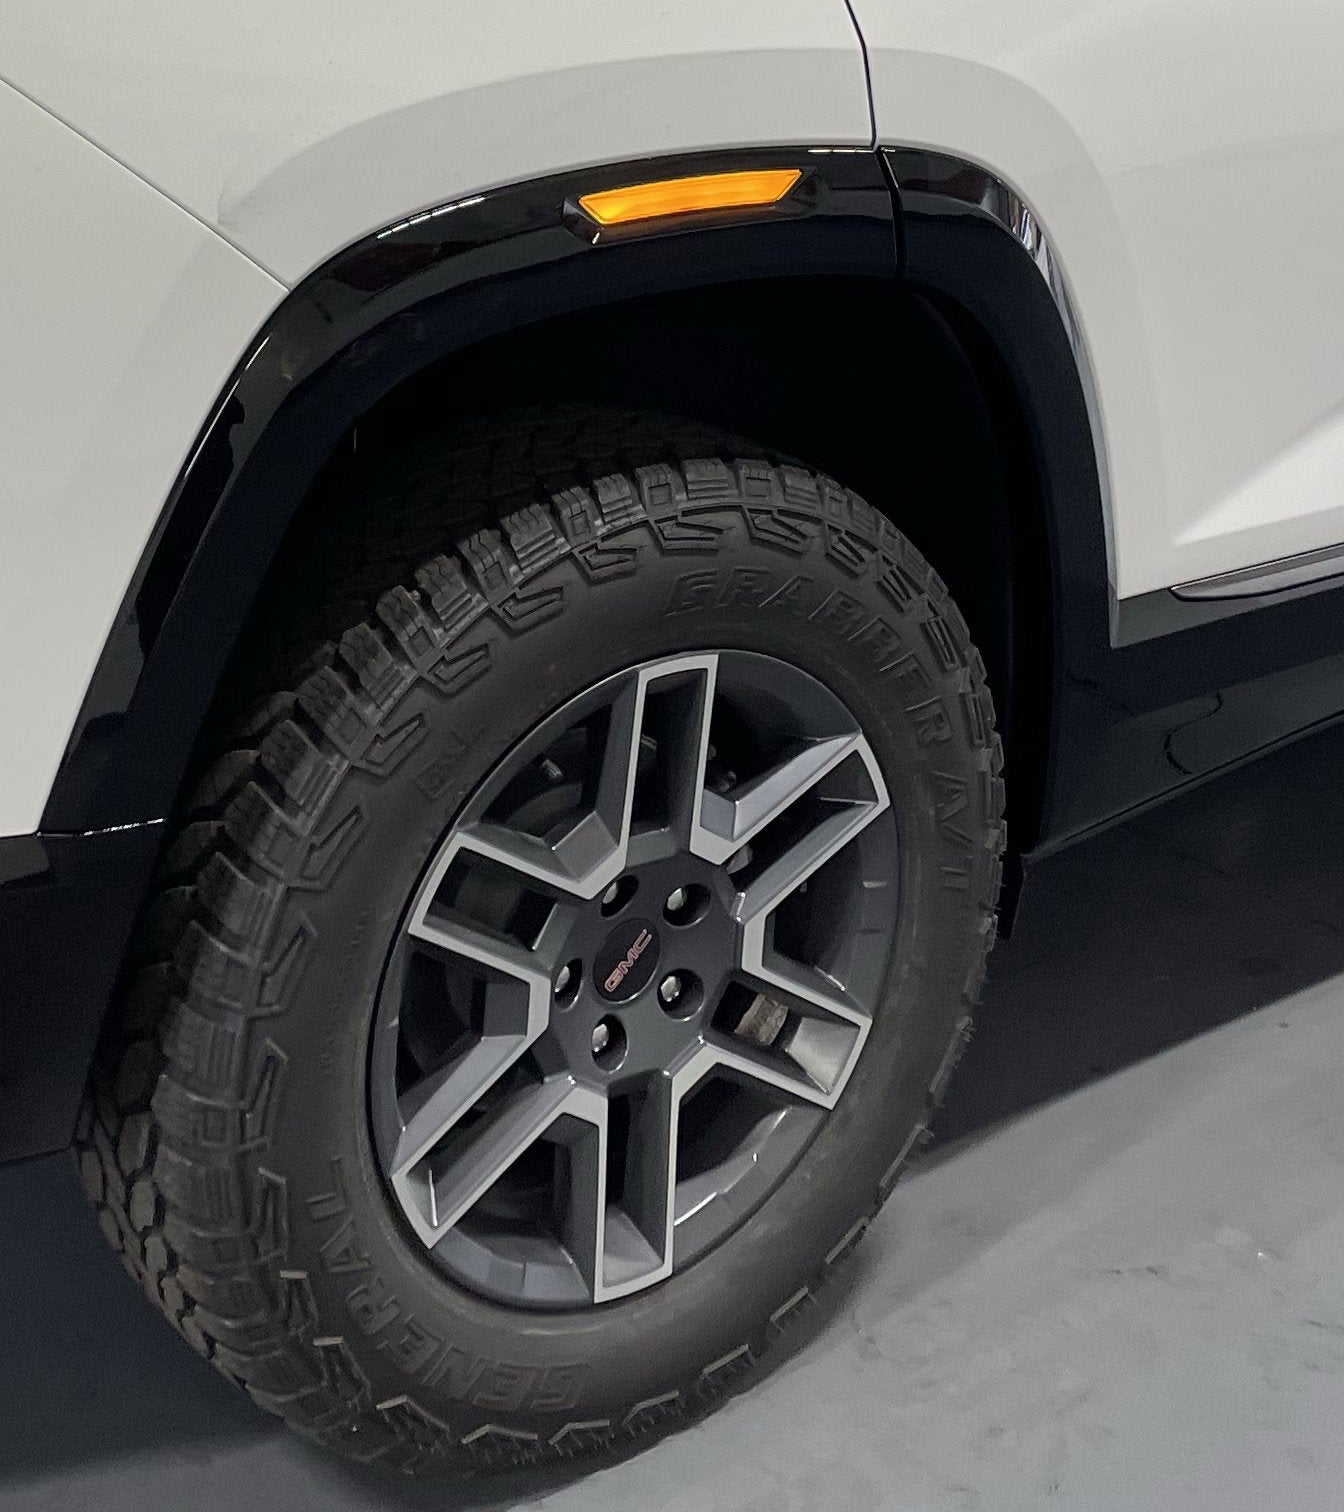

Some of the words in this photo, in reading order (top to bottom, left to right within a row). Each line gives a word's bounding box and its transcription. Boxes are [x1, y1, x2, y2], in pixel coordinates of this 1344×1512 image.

[664, 566, 954, 746] GRABBER
[604, 928, 653, 992] GMC
[306, 1155, 591, 1410] GENERAL
